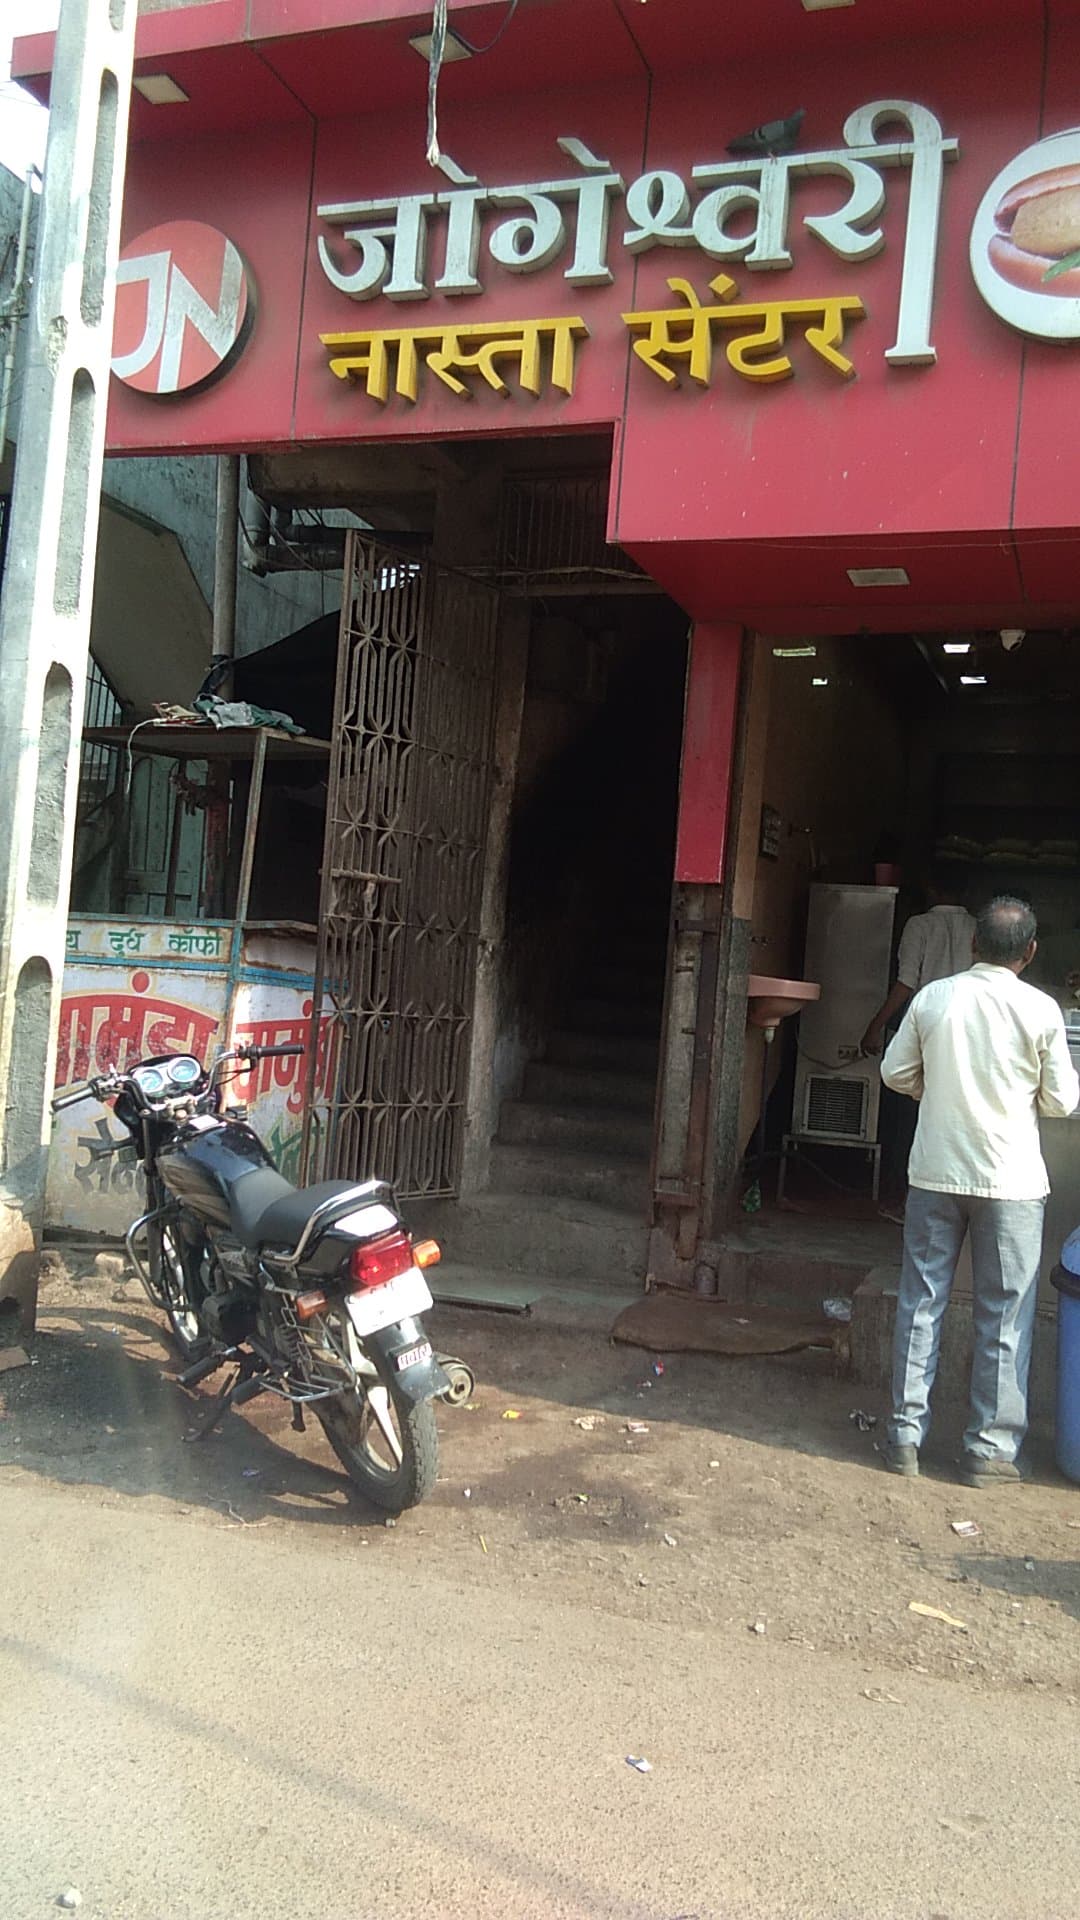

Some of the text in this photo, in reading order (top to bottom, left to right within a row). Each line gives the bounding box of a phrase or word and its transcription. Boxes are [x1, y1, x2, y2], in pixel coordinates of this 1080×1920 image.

[316, 99, 959, 366] जोगेश्वरी
[318, 273, 868, 404] नास्ता सेंटर
